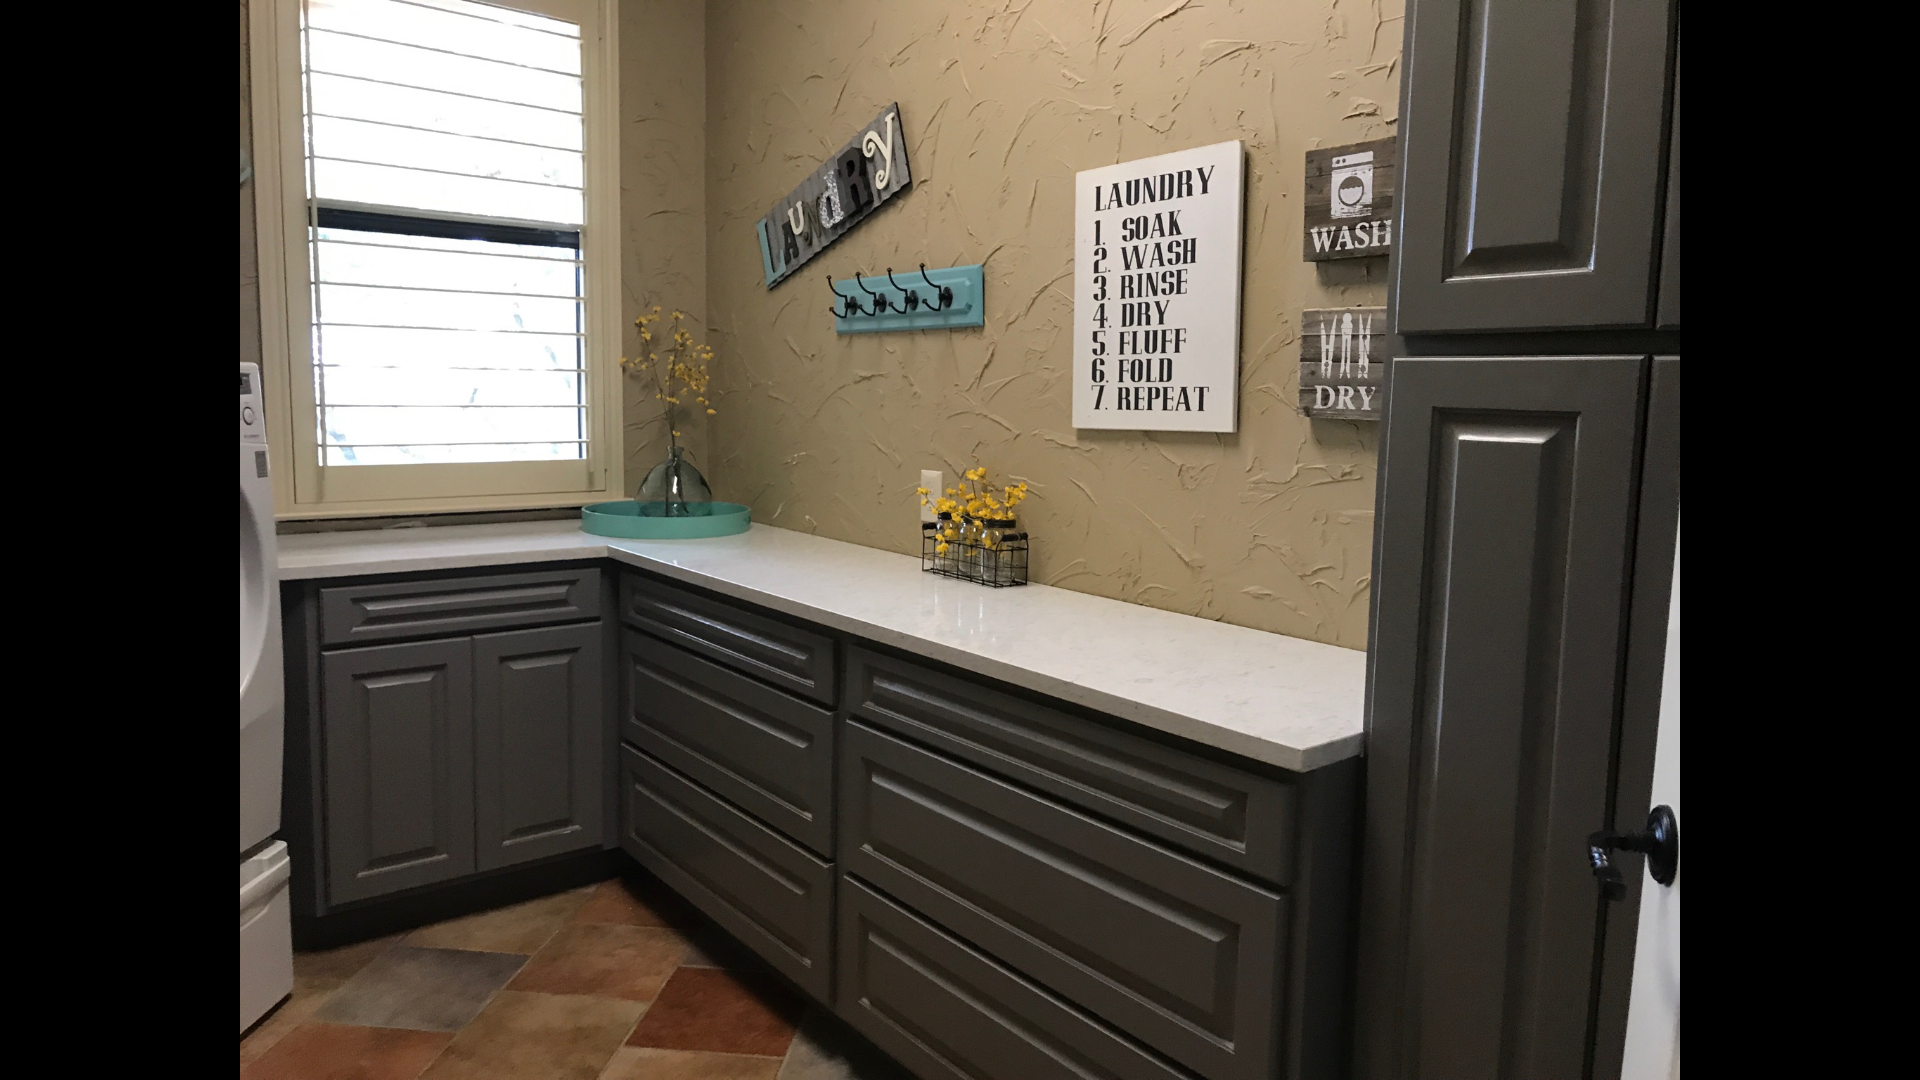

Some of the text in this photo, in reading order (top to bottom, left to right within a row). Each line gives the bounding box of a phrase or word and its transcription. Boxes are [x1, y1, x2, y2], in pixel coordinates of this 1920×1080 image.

[1094, 165, 1216, 212] LAUNDRY
[1094, 210, 1182, 246] 1. SOAK
[1309, 219, 1392, 253] WASH
[1093, 237, 1197, 274] 2. WASH
[1092, 268, 1188, 301] 3. RINSE
[1092, 300, 1170, 329] 4. DRY
[1092, 328, 1187, 356] 5. FLUFF
[1091, 357, 1173, 383] 6. FOLD
[1091, 384, 1210, 412] 7. REPEAT
[1313, 384, 1377, 411] DRY
